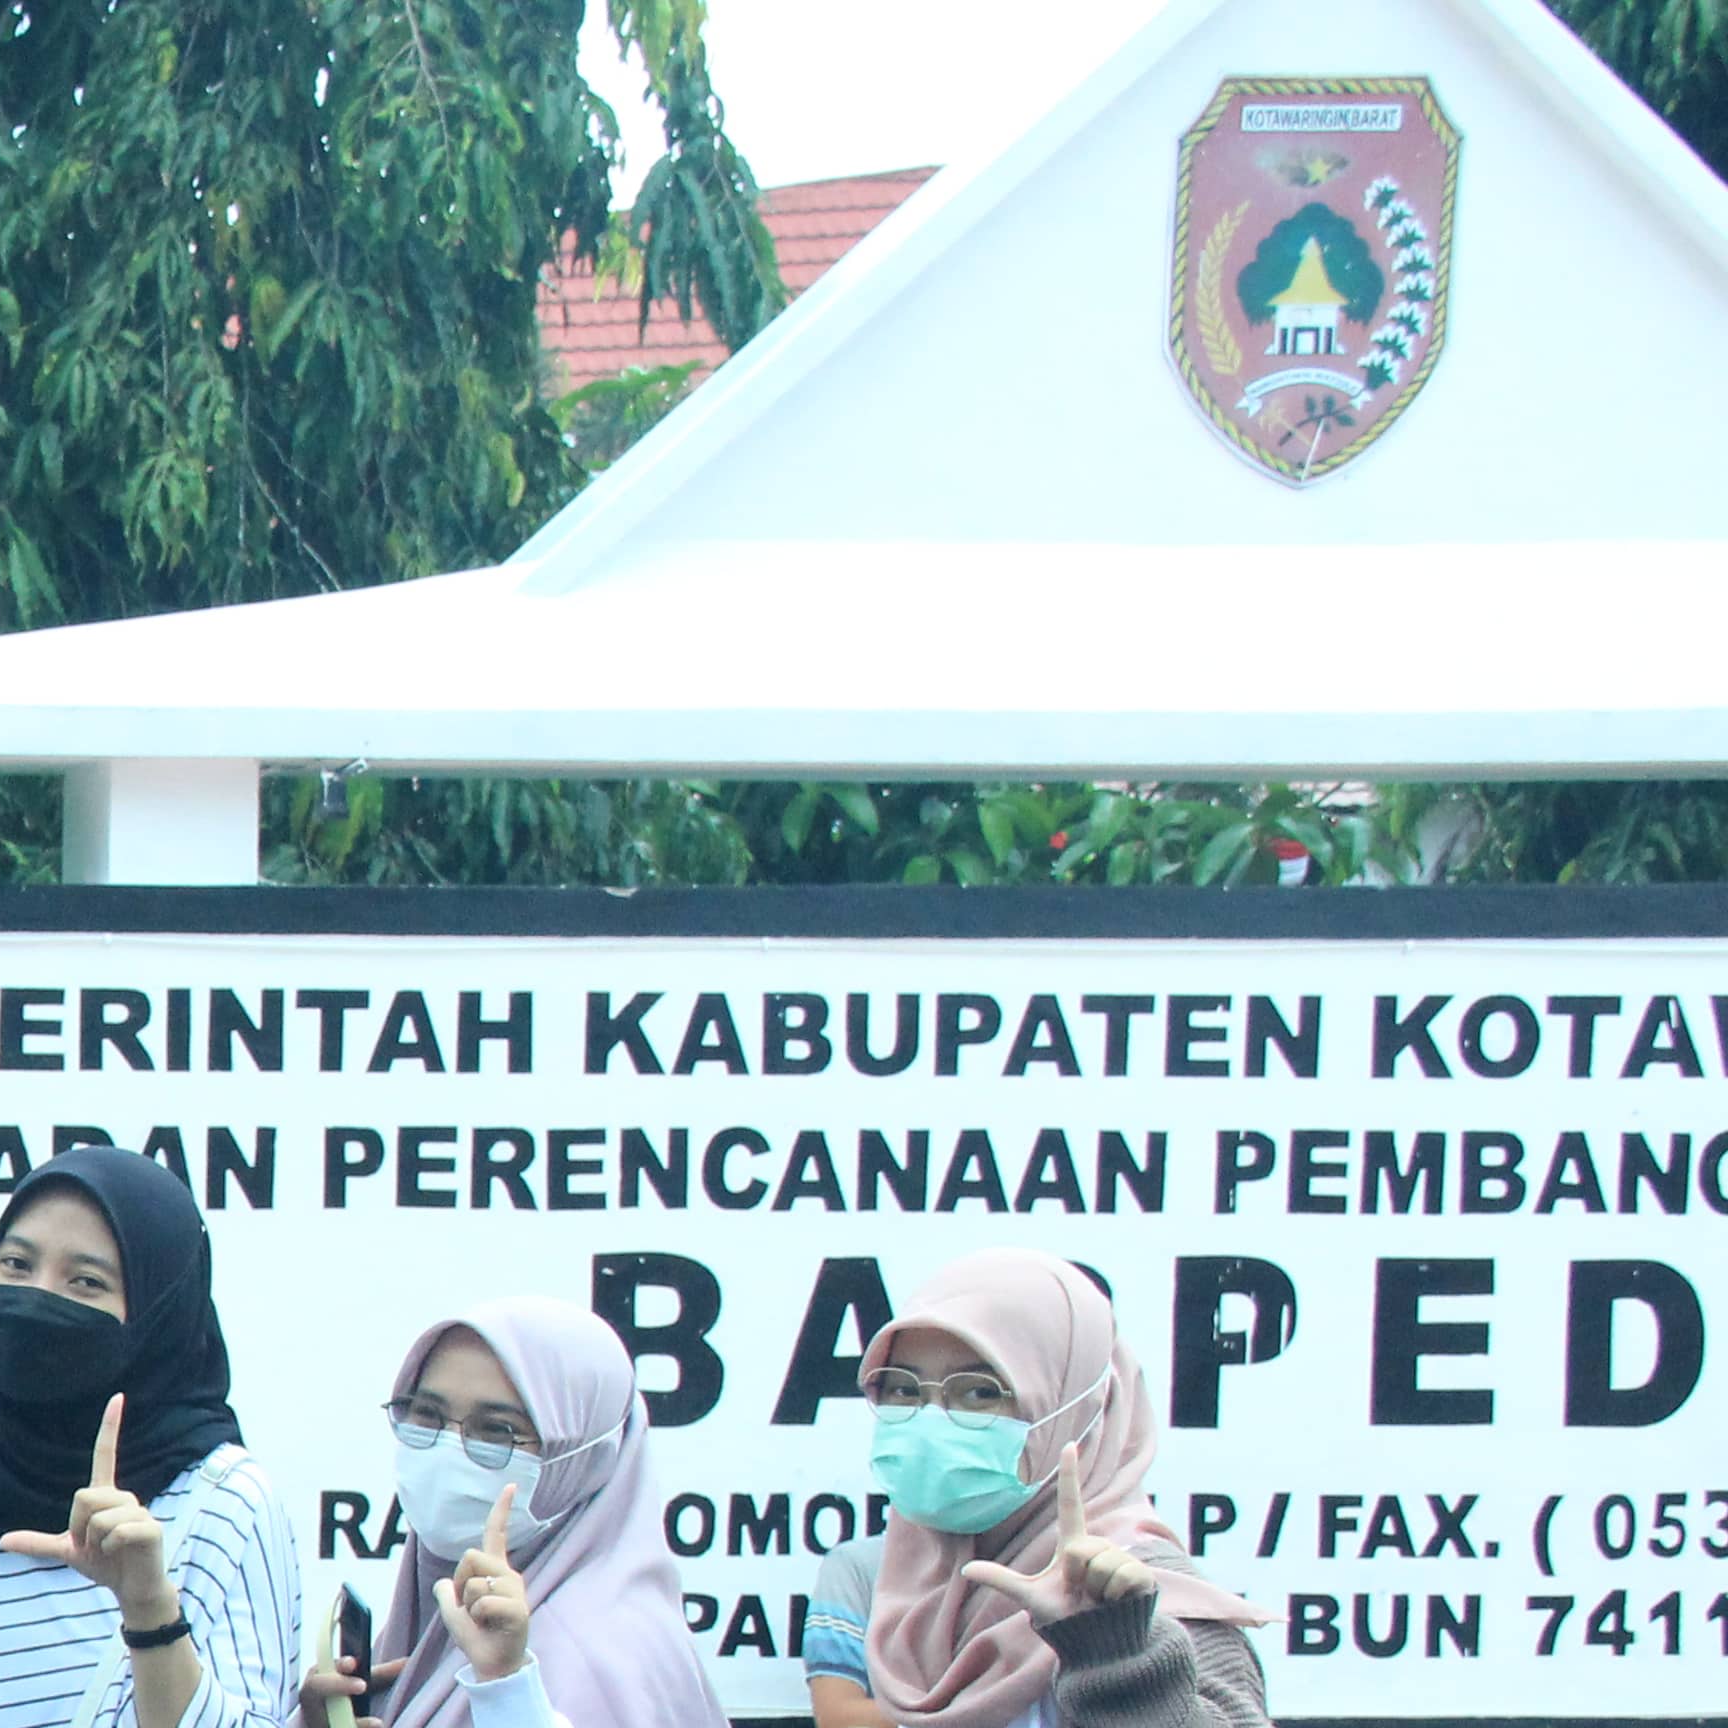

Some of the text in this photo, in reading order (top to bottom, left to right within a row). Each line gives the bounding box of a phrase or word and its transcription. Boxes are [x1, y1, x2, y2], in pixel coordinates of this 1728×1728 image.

[1350, 108, 1399, 128] BARAT
[583, 991, 1323, 1078] KABUPATEN
[1370, 994, 1728, 1079] KOTA
[322, 1126, 1168, 1214] PERENCANAAN
[591, 1251, 1706, 1428] BAPED
[1317, 1493, 1500, 1559] FAX.
[1286, 1592, 1482, 1659] BUN
